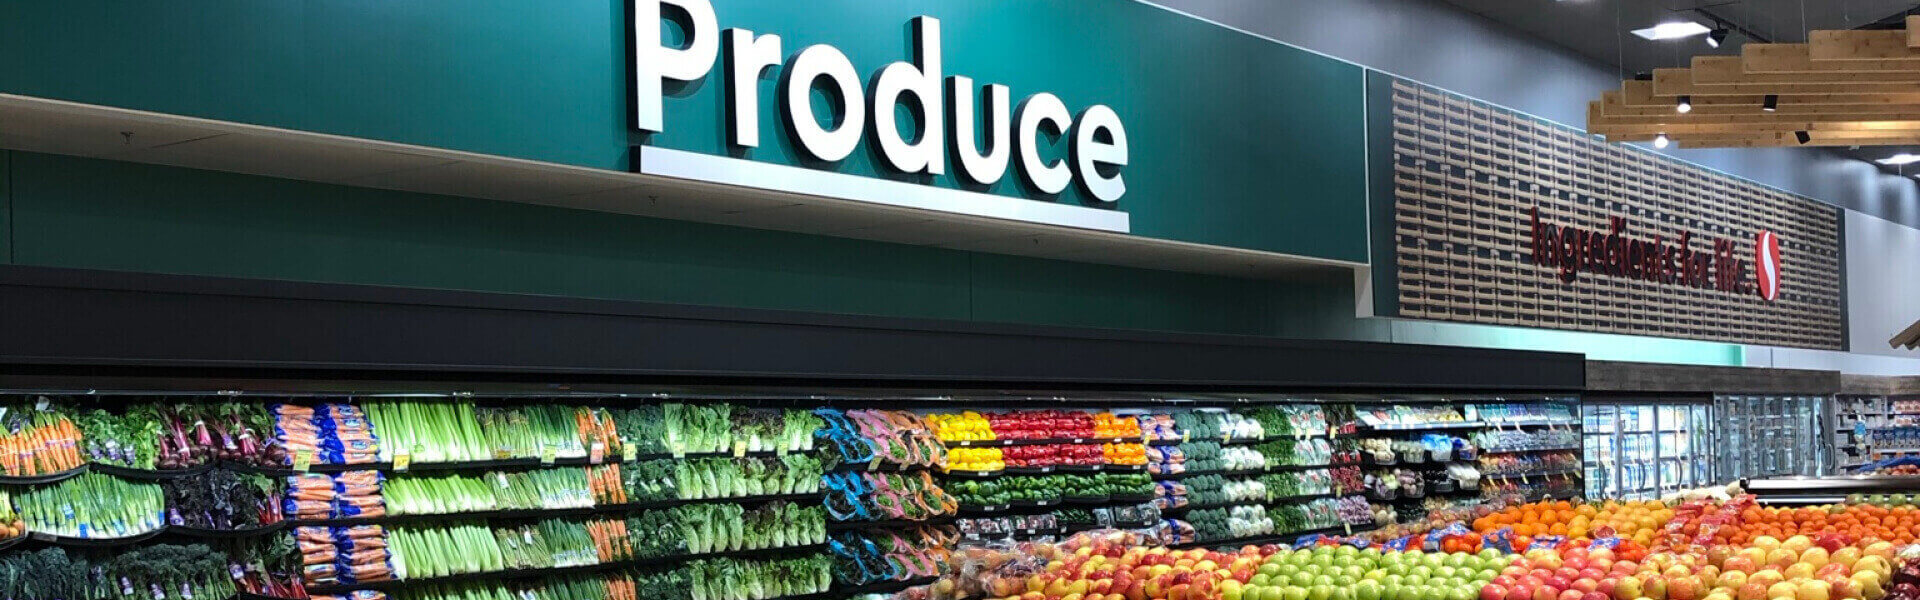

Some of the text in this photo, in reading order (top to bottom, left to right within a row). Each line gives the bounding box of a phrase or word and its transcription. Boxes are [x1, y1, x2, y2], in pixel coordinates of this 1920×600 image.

[633, 0, 1129, 202] Produce
[1531, 206, 1676, 284] Ingredients
[1680, 229, 1712, 289] for
